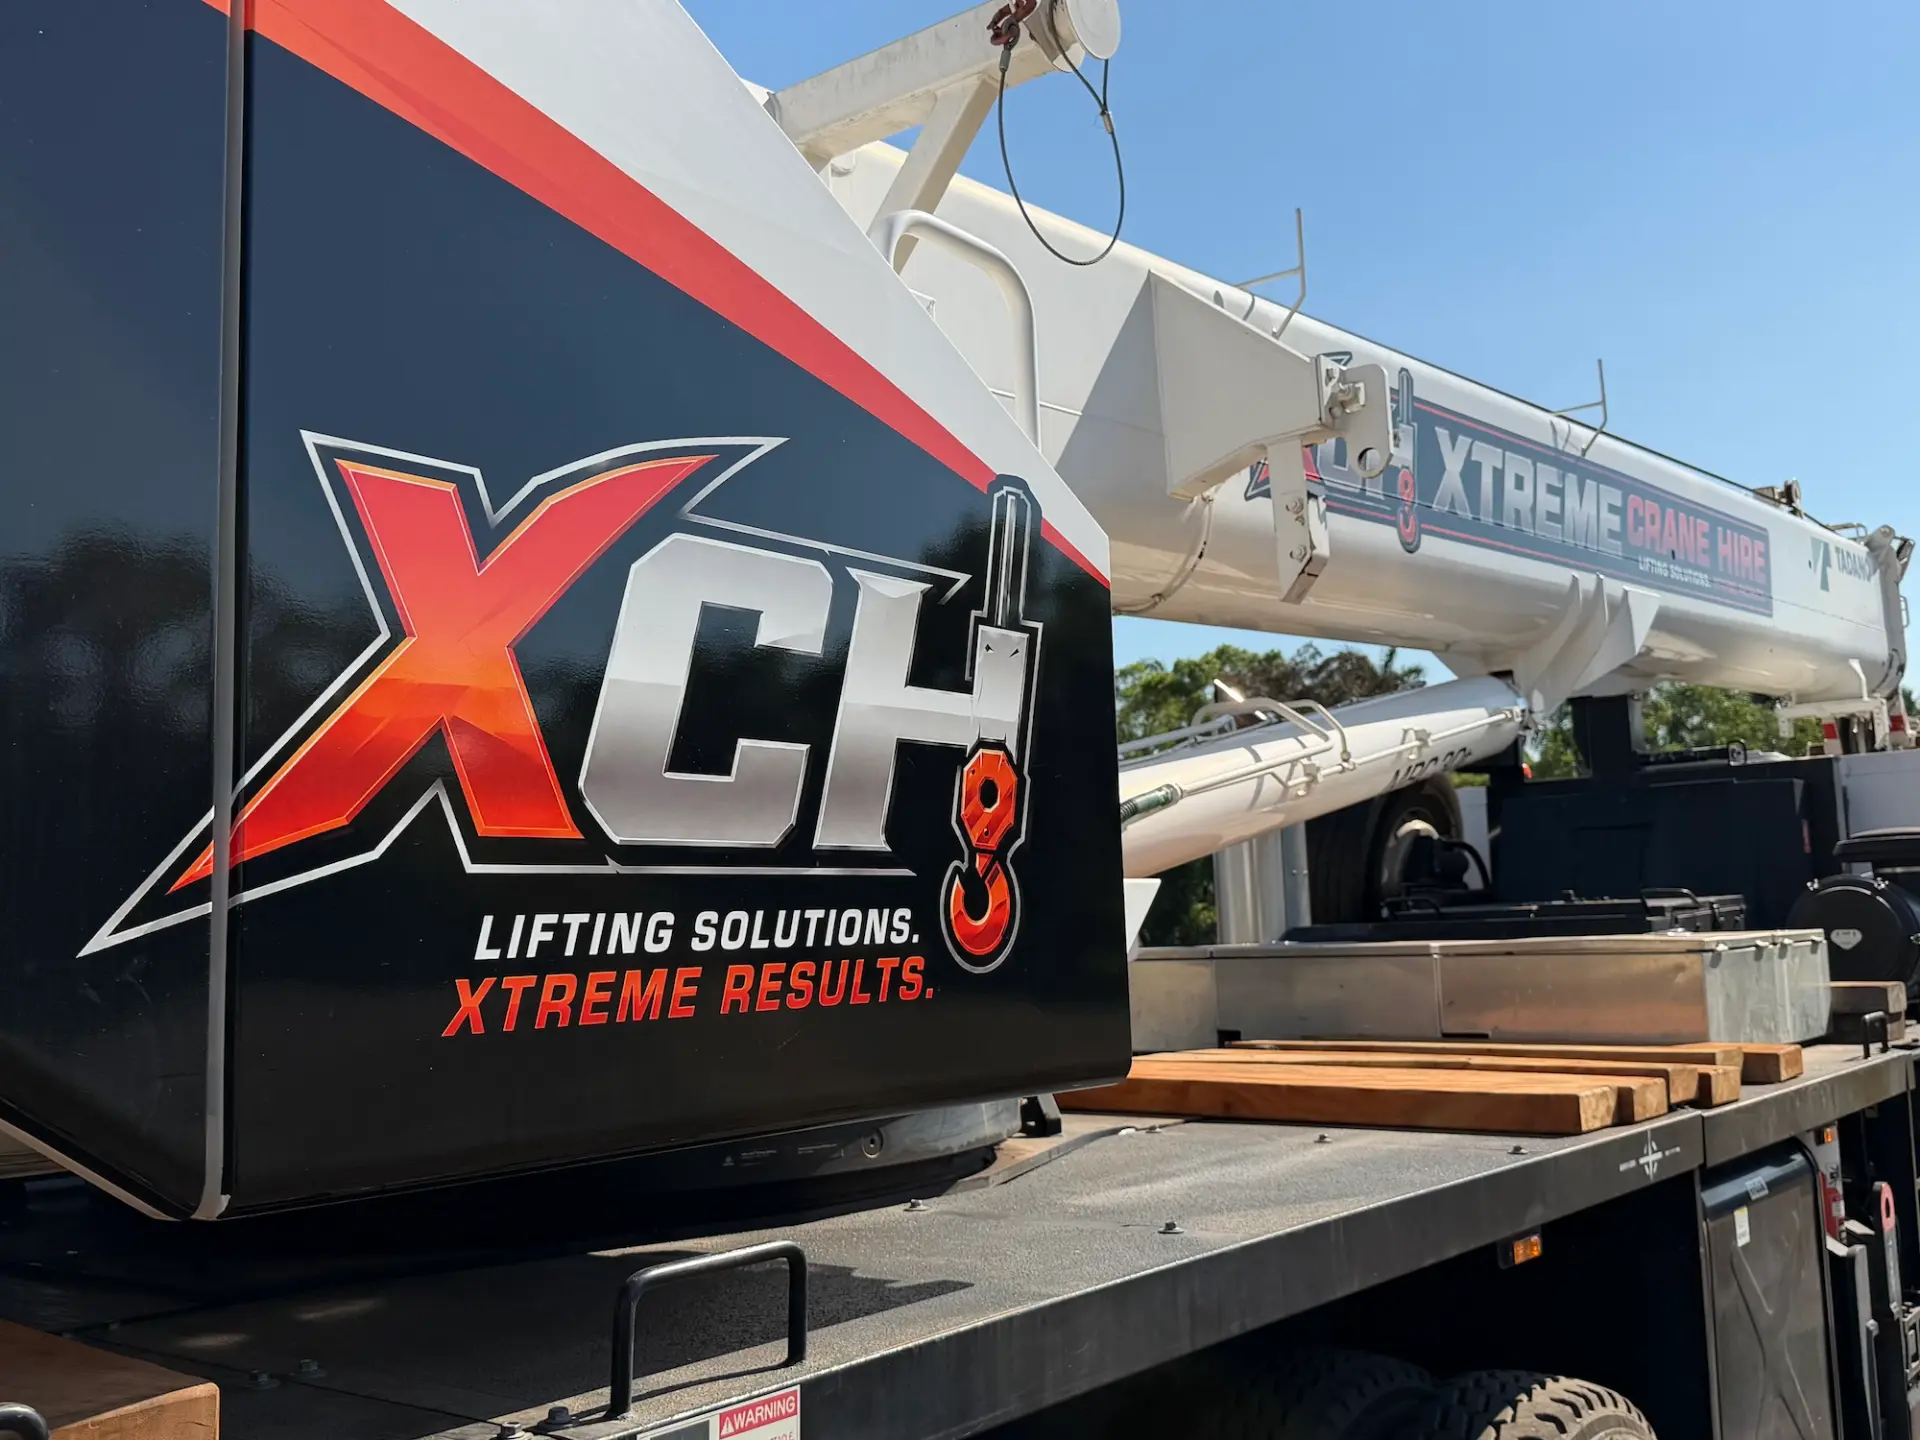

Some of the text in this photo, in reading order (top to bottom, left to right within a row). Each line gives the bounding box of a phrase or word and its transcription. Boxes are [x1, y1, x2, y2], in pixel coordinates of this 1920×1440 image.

[1432, 426, 1767, 585] XTREME CRANE HIRE
[168, 454, 1028, 894] XCH
[474, 907, 920, 960] LIFTING SOLUTIONS.
[441, 956, 934, 1037] XTREME RESULTS.
[734, 1396, 796, 1430] WARNING
